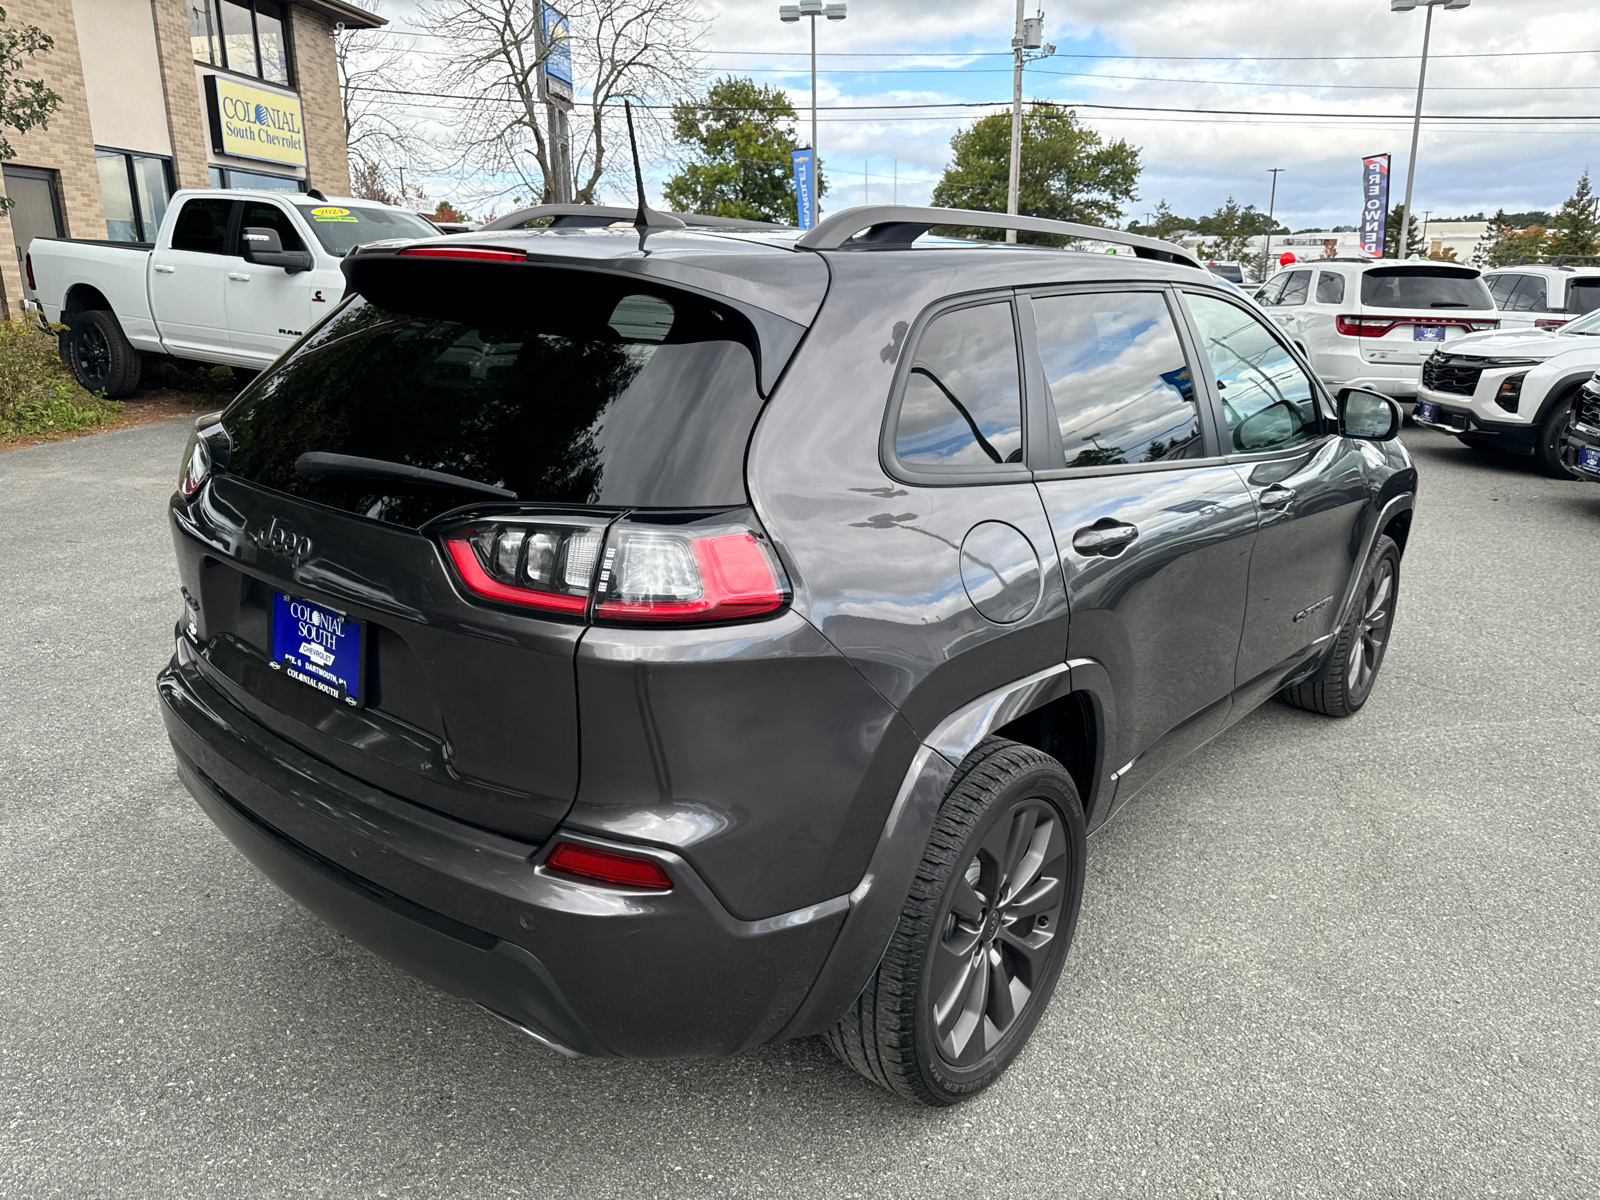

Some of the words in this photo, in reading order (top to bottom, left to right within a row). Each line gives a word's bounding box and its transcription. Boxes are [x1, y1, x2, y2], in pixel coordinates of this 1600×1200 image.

[223, 96, 300, 134] COLONIAL
[226, 121, 256, 141] South
[258, 128, 302, 150] Chevrolet
[278, 328, 302, 336] RAM
[258, 515, 313, 569] Jeep
[290, 602, 345, 637] COLONIAL
[298, 621, 336, 650] SOUTH
[302, 645, 332, 662] CHEVROLET
[287, 668, 318, 689] COLONIAL
[317, 682, 339, 699] SOUTH
[297, 659, 302, 667] 6
[305, 662, 338, 685] DARTMOUTH,
